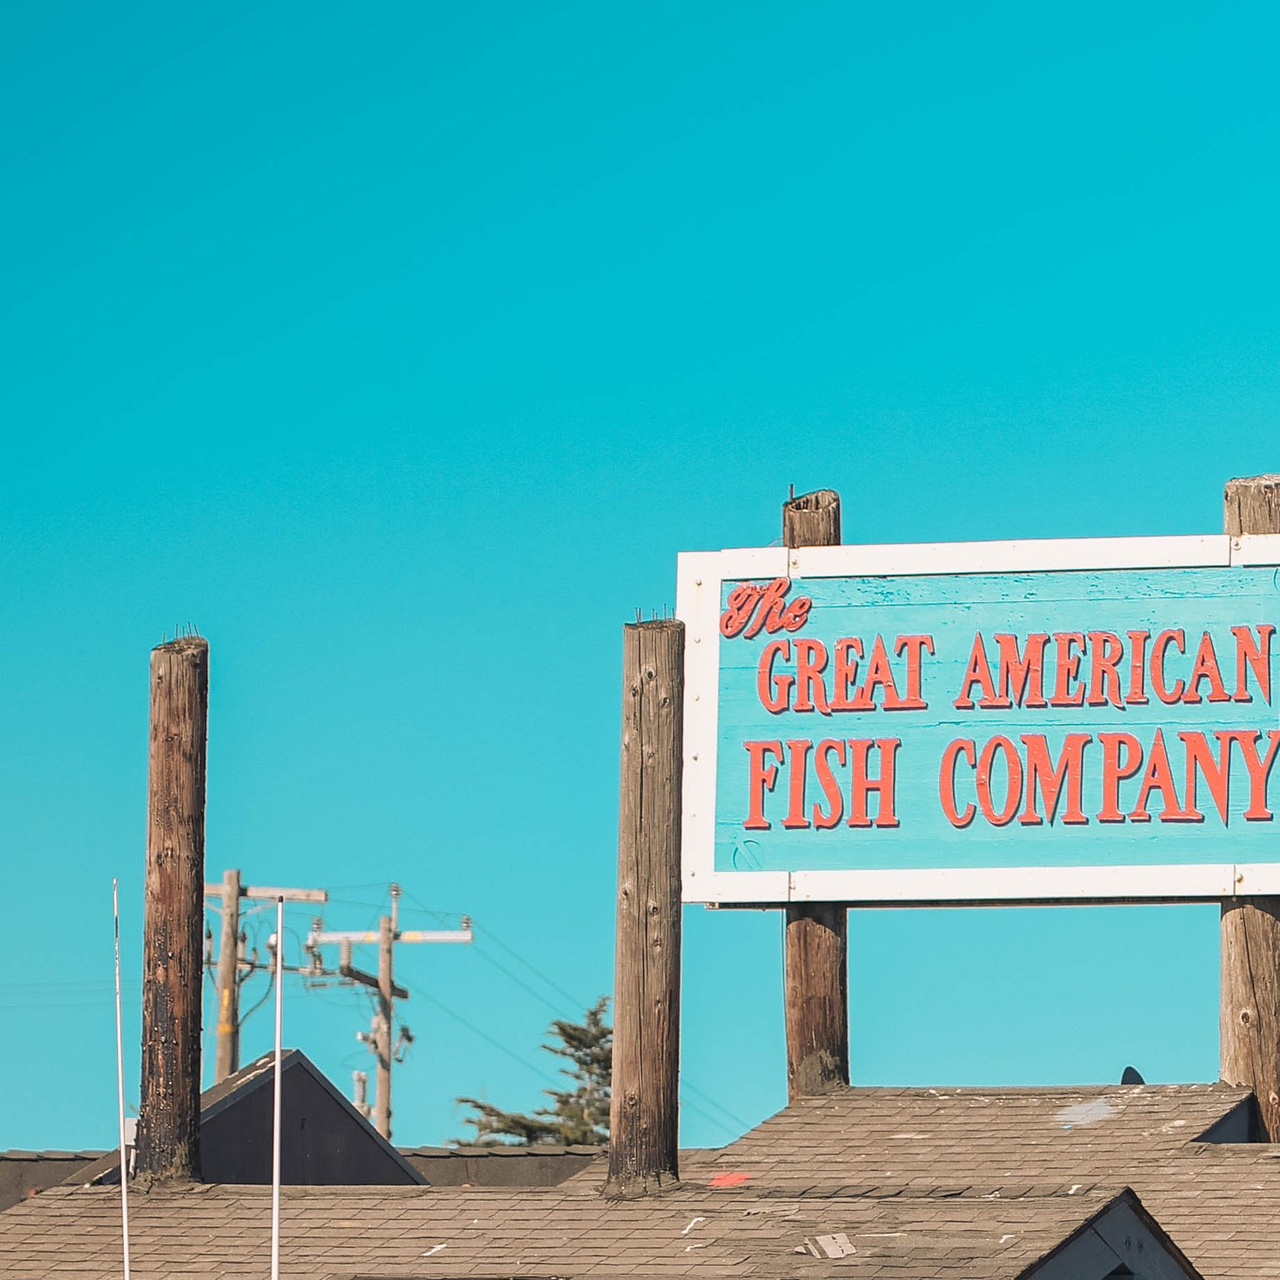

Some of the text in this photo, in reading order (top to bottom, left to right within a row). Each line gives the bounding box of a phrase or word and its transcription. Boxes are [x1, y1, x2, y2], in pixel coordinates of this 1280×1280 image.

[719, 576, 812, 638] The
[756, 623, 1277, 715] GREAT AMERICAN
[742, 736, 903, 830] FISH
